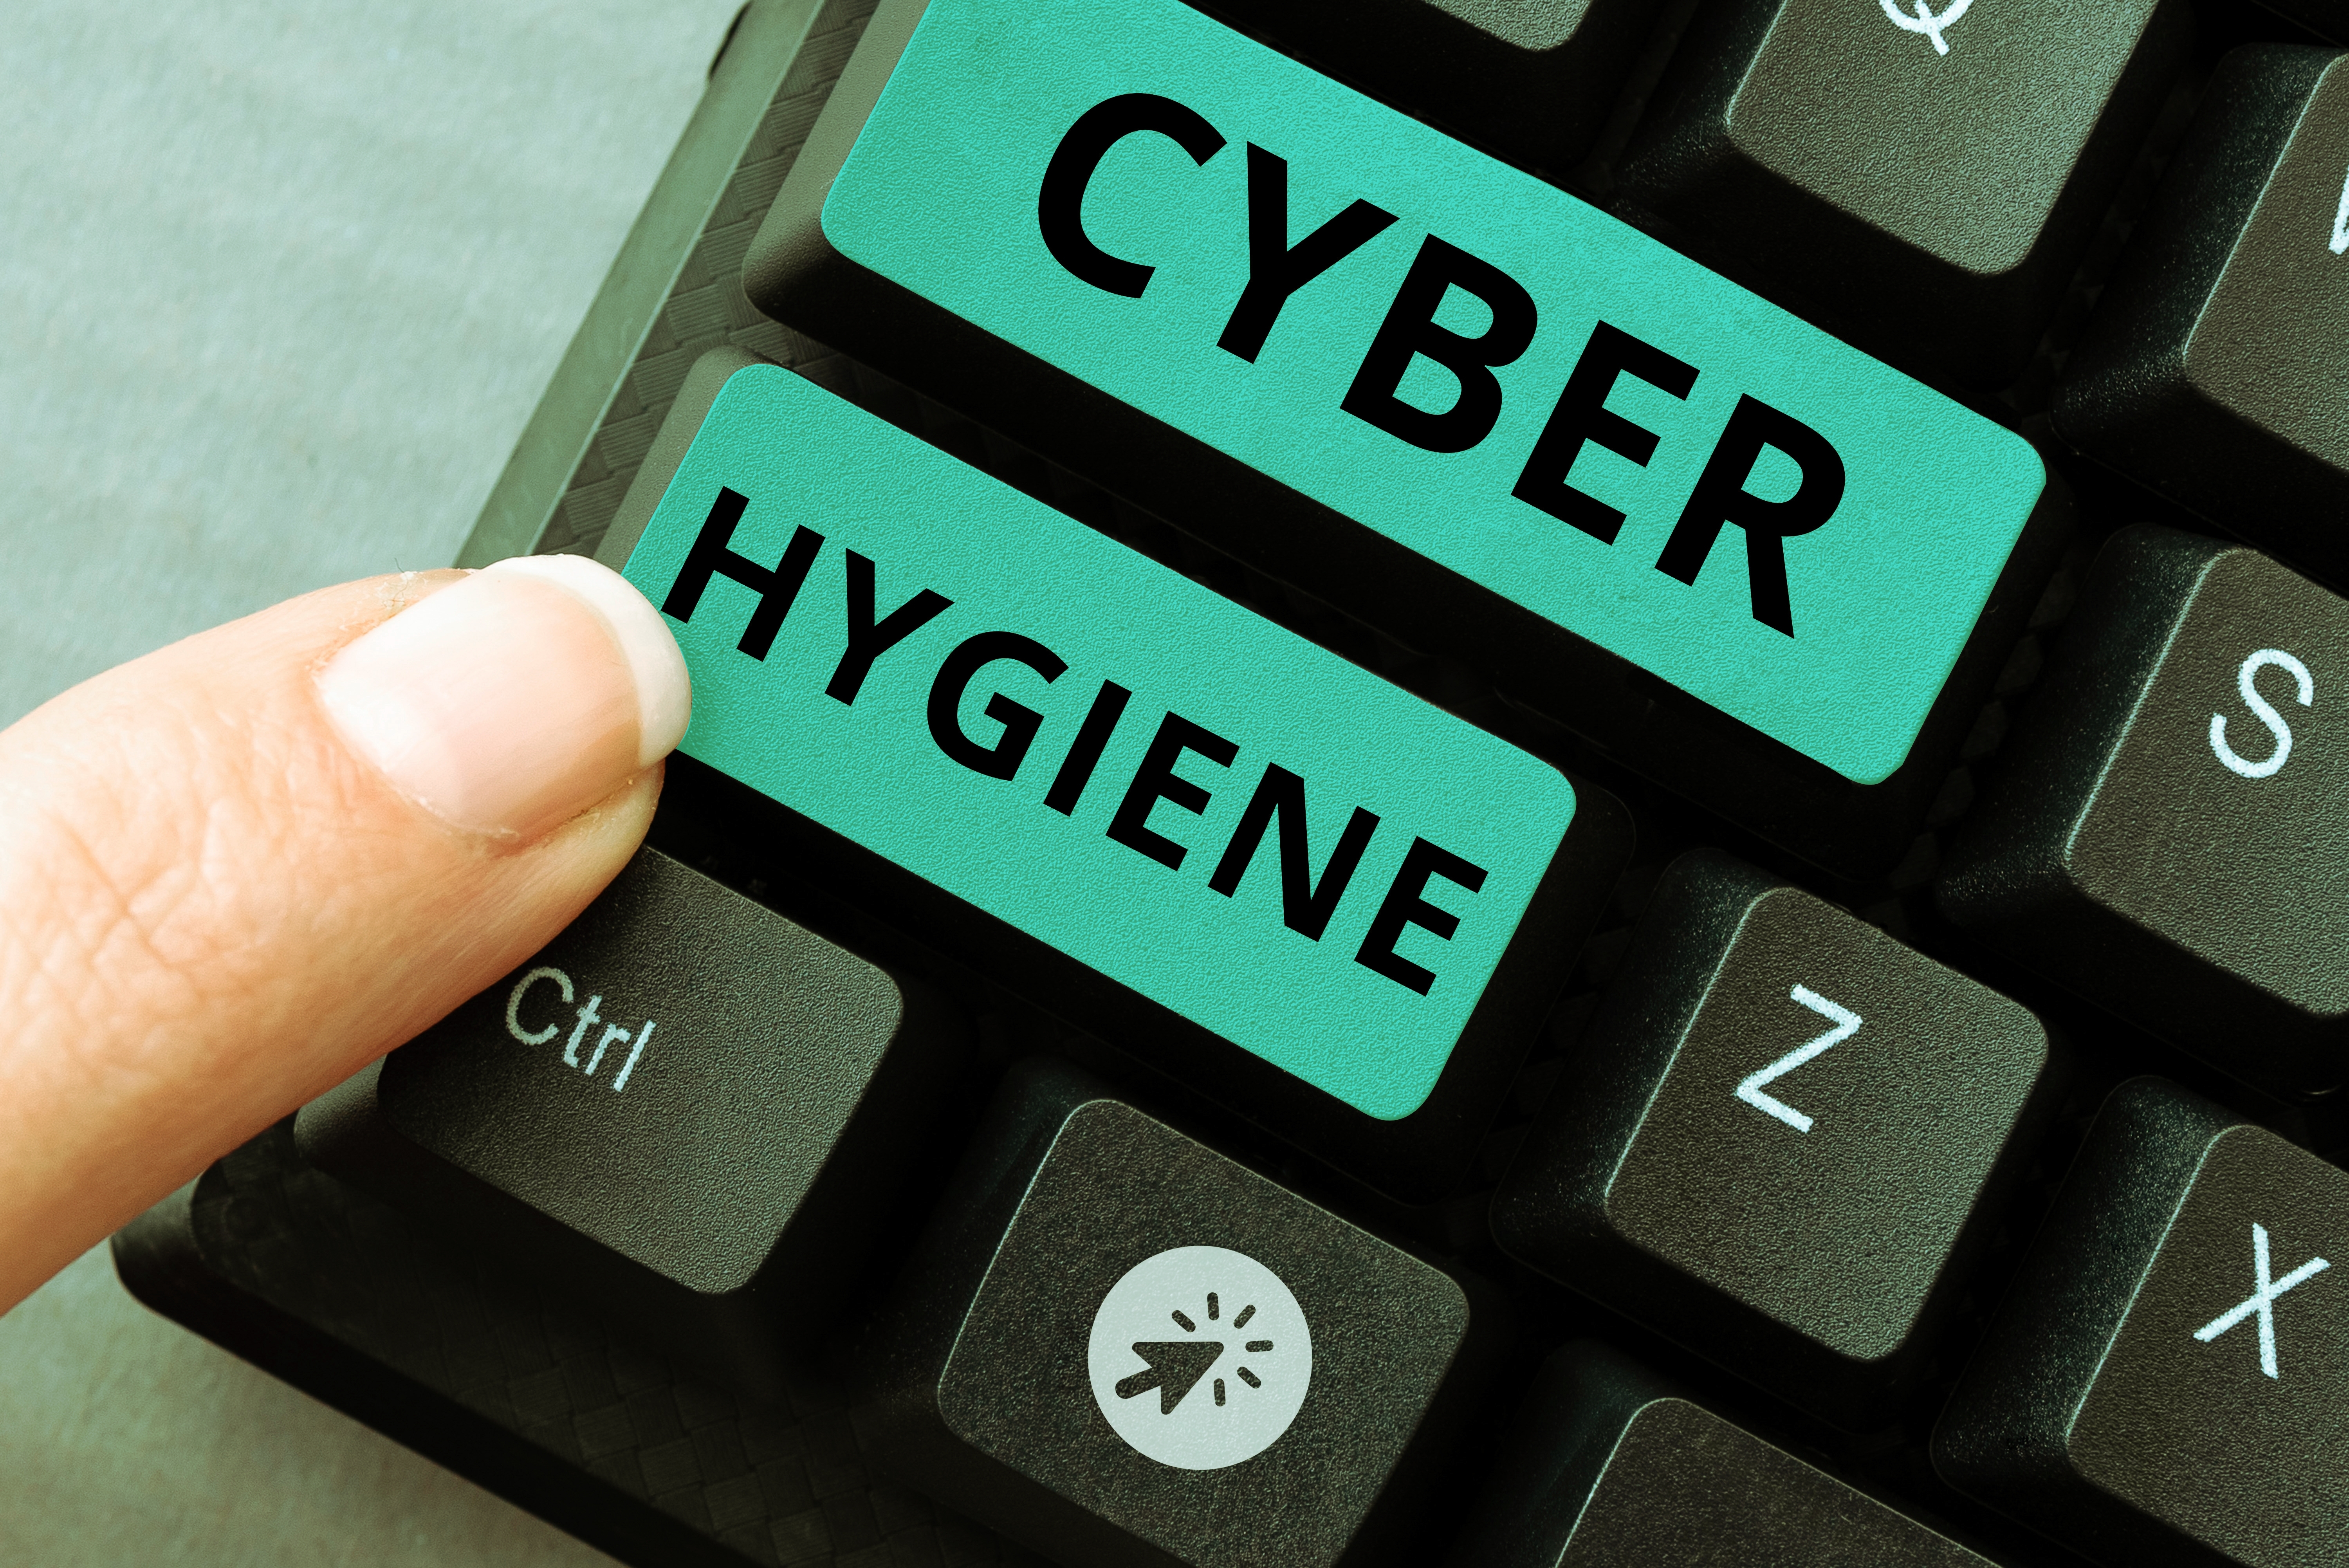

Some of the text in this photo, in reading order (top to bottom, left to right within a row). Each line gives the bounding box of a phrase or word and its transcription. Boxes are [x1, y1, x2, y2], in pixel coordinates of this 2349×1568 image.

[2209, 649, 2314, 778] S
[507, 966, 657, 1092] Ctrl
[1734, 983, 1863, 1133] Z
[2194, 1223, 2331, 1379] X
